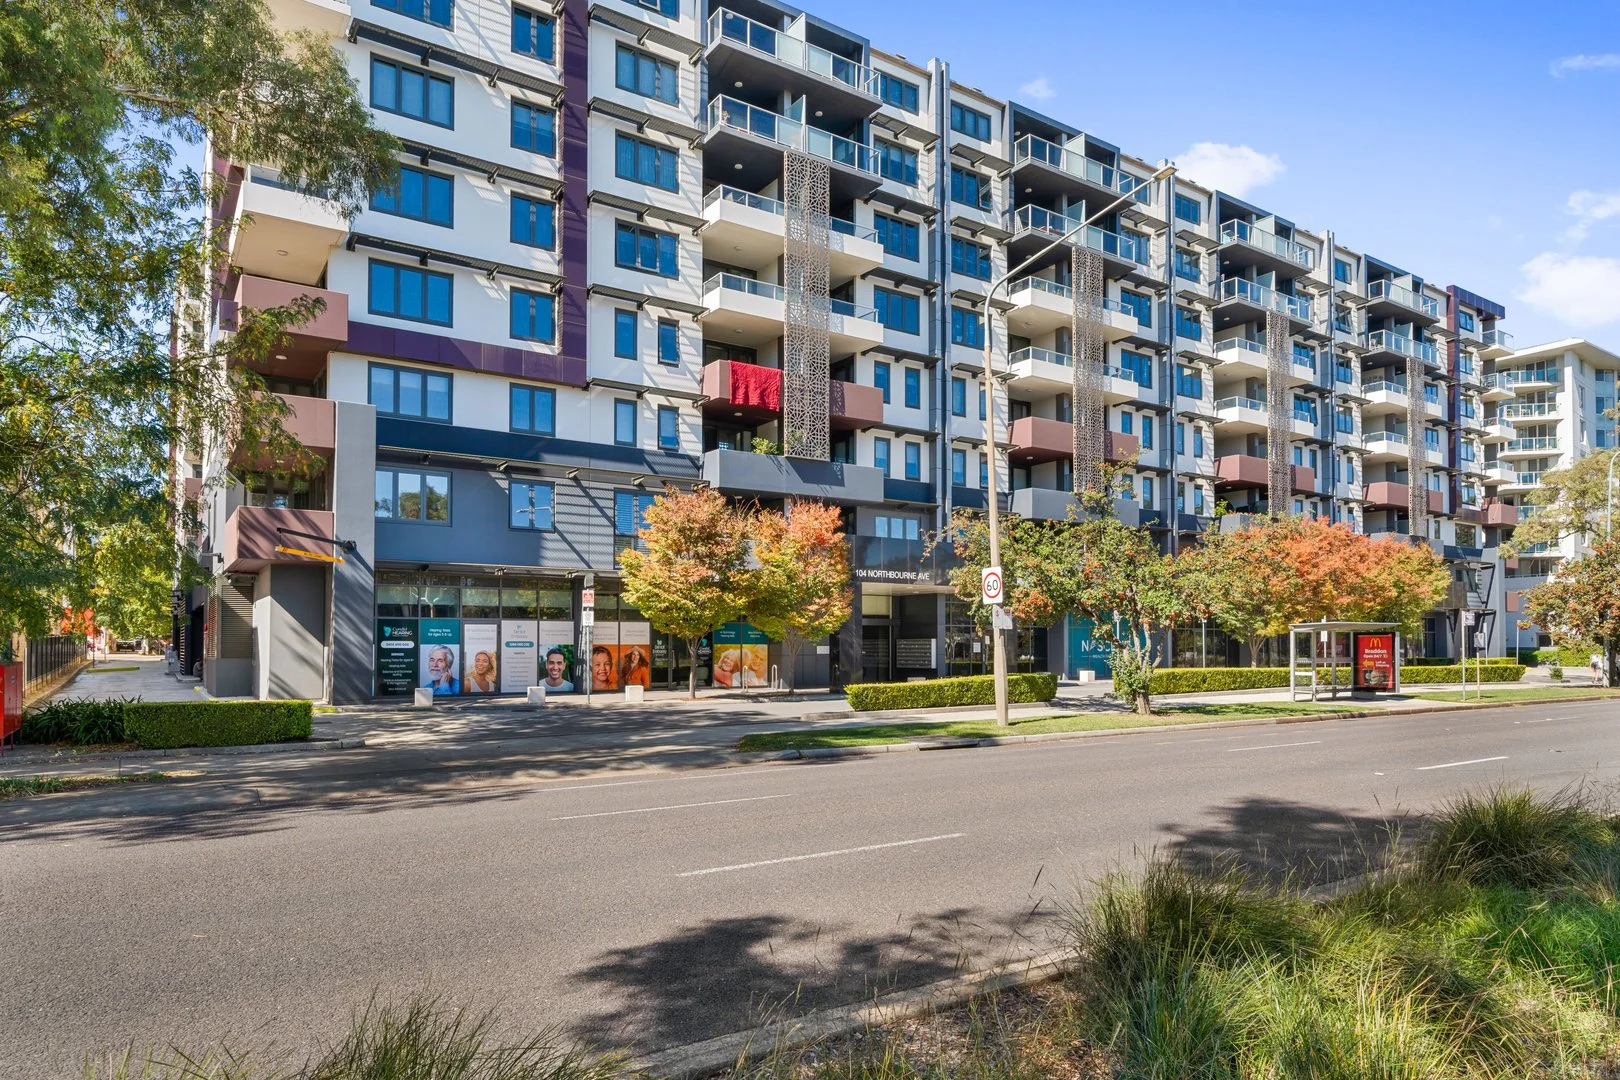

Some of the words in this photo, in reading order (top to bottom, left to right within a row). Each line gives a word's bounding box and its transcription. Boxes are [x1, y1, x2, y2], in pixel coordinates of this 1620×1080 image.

[855, 569, 867, 577] 104
[868, 569, 917, 580] NORTHBOURNE
[917, 572, 930, 580] AVE
[986, 579, 999, 592] 60
